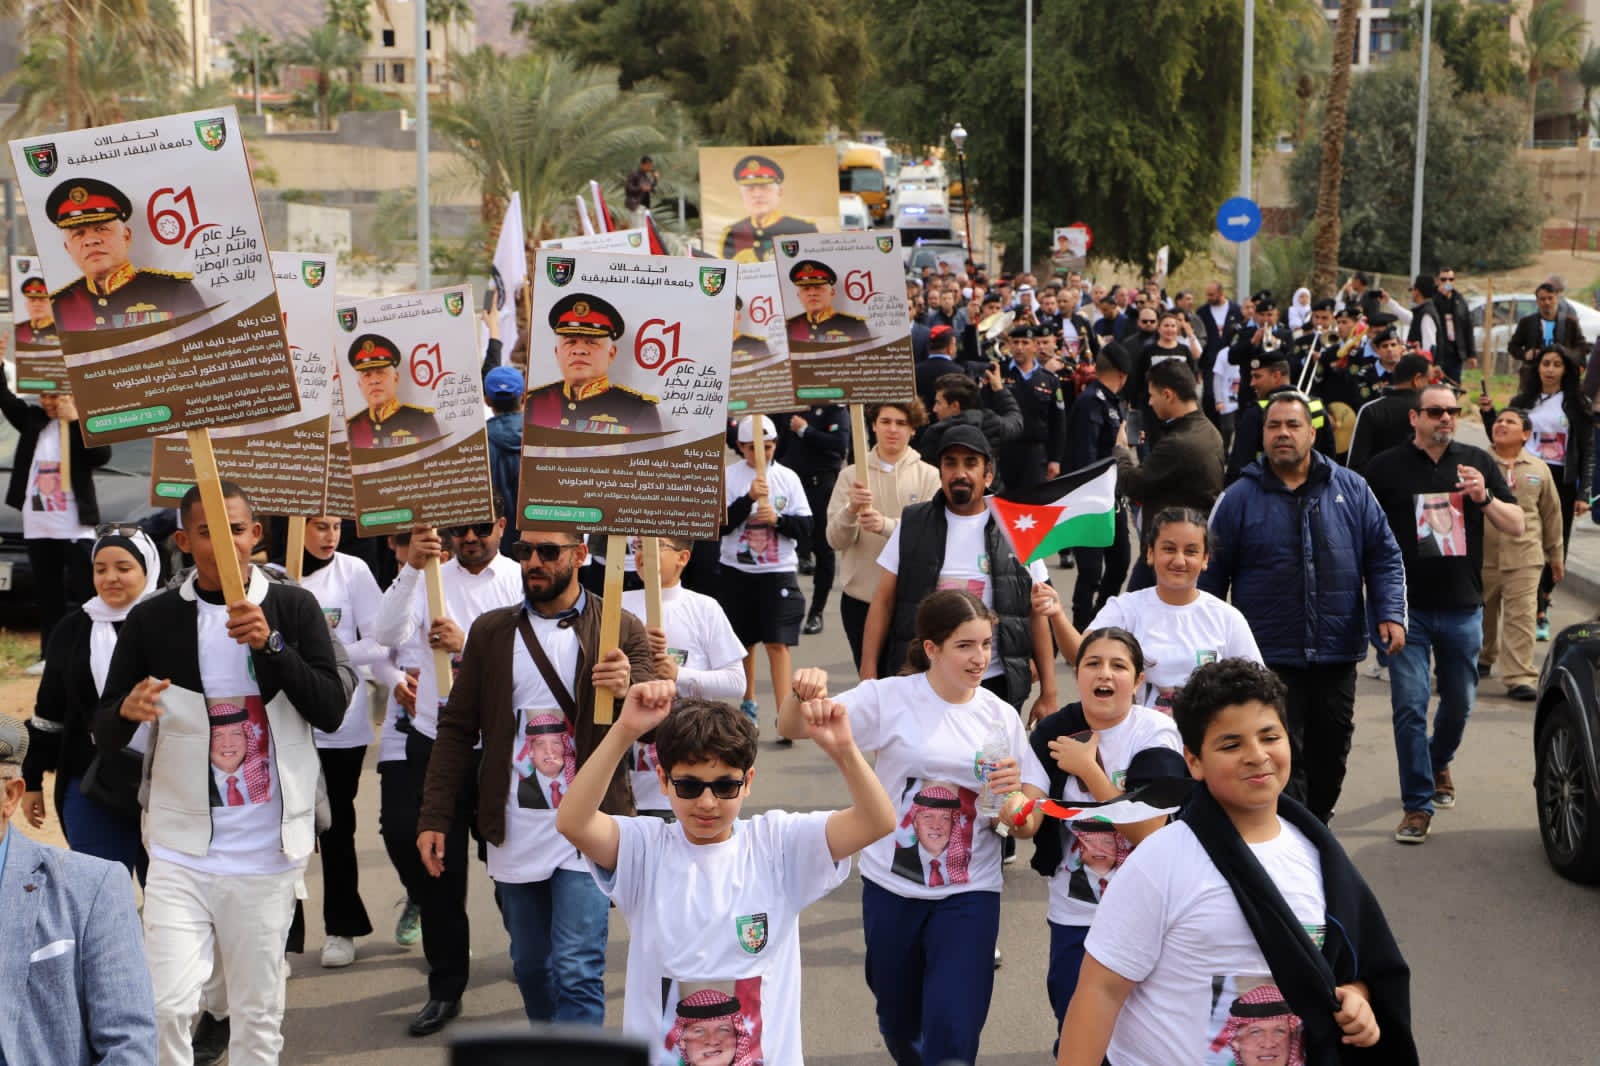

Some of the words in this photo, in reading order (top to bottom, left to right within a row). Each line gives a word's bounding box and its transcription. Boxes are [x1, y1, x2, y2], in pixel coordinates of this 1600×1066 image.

[123, 143, 157, 156] البلقاء
[159, 138, 193, 150] جامعة
[67, 148, 121, 166] التطبيقية
[146, 186, 200, 245] 61
[199, 229, 222, 244] عام
[226, 226, 247, 240] كل
[194, 244, 220, 259] بخير
[225, 237, 256, 255] وانتم
[196, 257, 229, 274] الوطن
[232, 252, 262, 266] وقائد
[210, 272, 230, 288] خير
[233, 268, 255, 281] بالف
[274, 271, 297, 280] جامع
[581, 274, 629, 283] التطبيقية
[631, 276, 662, 286] البلقاء
[664, 278, 694, 288] جامعة
[844, 270, 874, 301] 61
[749, 296, 773, 322] 61
[237, 318, 259, 328] رعاية
[260, 313, 276, 323] تحت
[226, 332, 250, 345] السيد
[251, 329, 279, 341] معالي
[182, 340, 204, 354] الفايز
[205, 337, 225, 347] نايف
[634, 318, 680, 370] 61
[292, 352, 301, 362] عا
[410, 342, 443, 387] 61
[675, 362, 694, 375] عام
[698, 365, 716, 377] كل
[178, 365, 198, 378] أحمد
[664, 375, 690, 389] بخير
[692, 377, 723, 390] وانتم
[662, 390, 694, 401] الوطن
[696, 392, 724, 404] وقائد
[671, 406, 689, 416] خير
[692, 405, 714, 418] بالف
[683, 448, 704, 459] رعاية
[704, 449, 720, 457] تحت
[628, 458, 650, 467] الفايز
[651, 459, 669, 469] نايف
[693, 462, 719, 471] معالي
